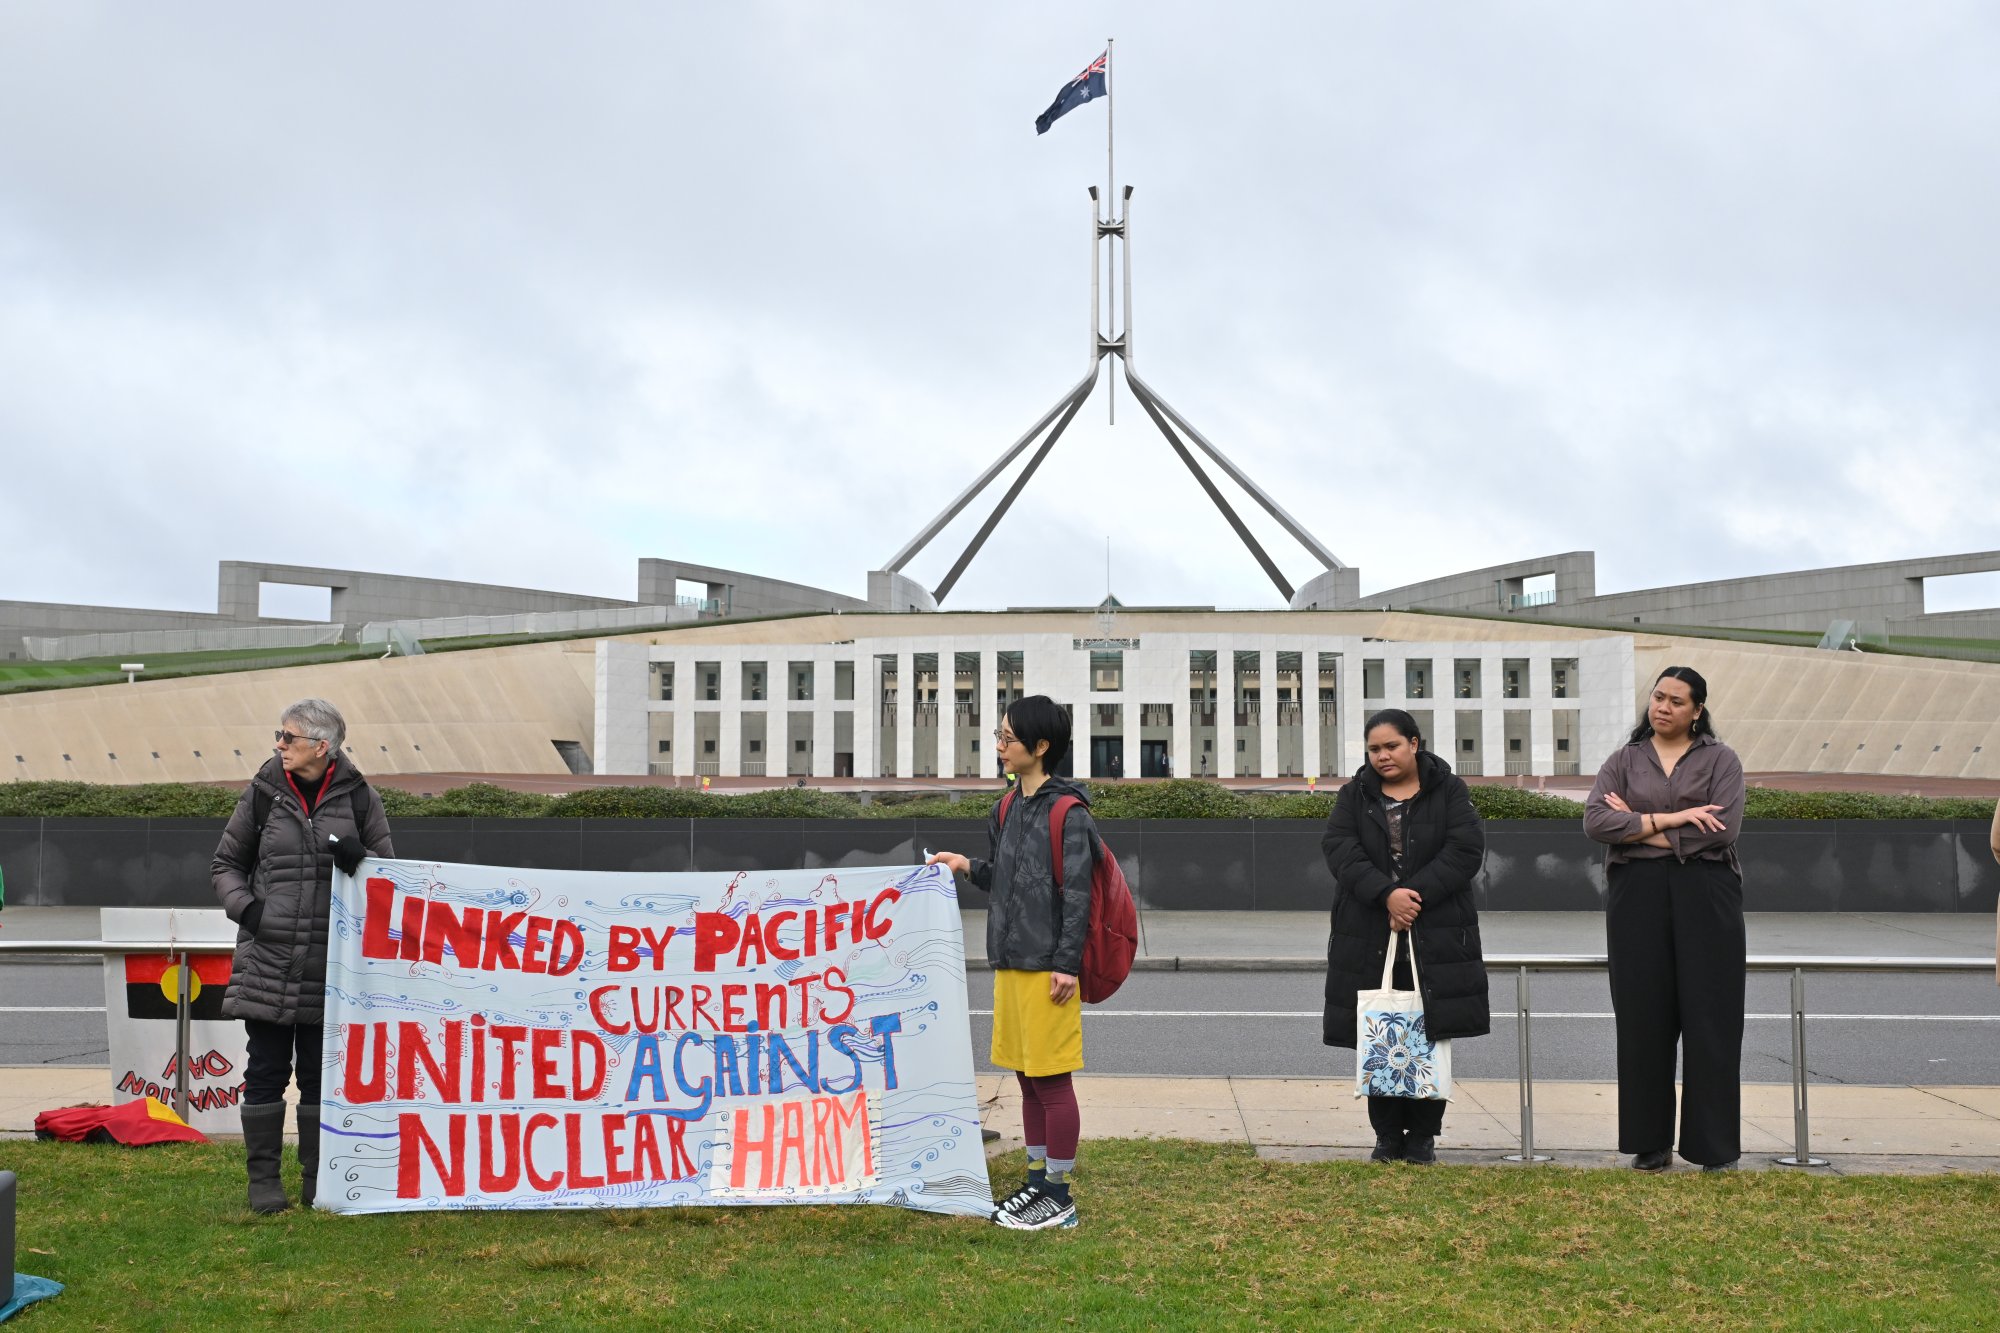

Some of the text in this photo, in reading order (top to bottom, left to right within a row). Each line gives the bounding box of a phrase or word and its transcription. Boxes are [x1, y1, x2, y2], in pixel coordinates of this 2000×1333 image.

[362, 877, 901, 977] LINKED BY PACIFIC
[397, 1091, 875, 1199] NUCLEAR HARM
